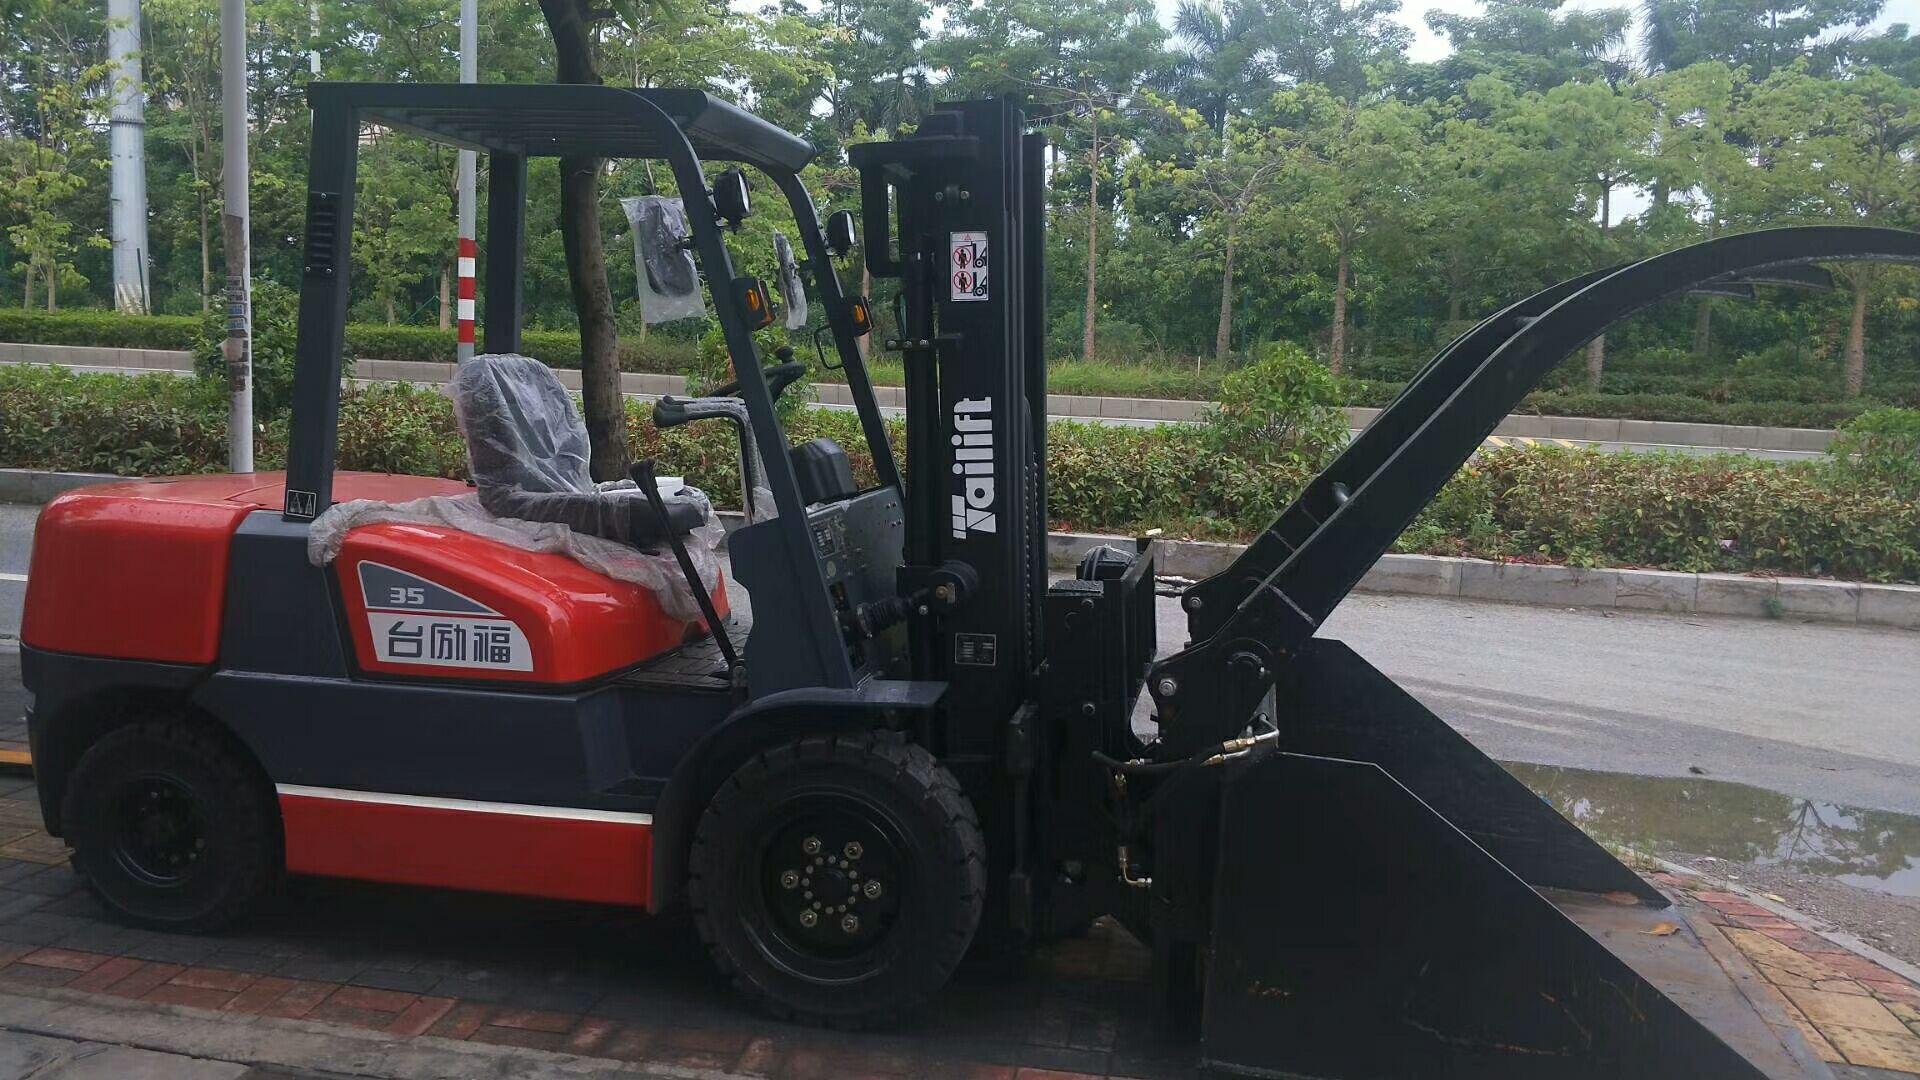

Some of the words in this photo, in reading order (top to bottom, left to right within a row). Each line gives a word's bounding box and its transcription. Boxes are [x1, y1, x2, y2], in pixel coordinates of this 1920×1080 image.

[951, 396, 997, 539] Tailift
[390, 587, 425, 605] 35
[388, 621, 511, 663] 台励福
